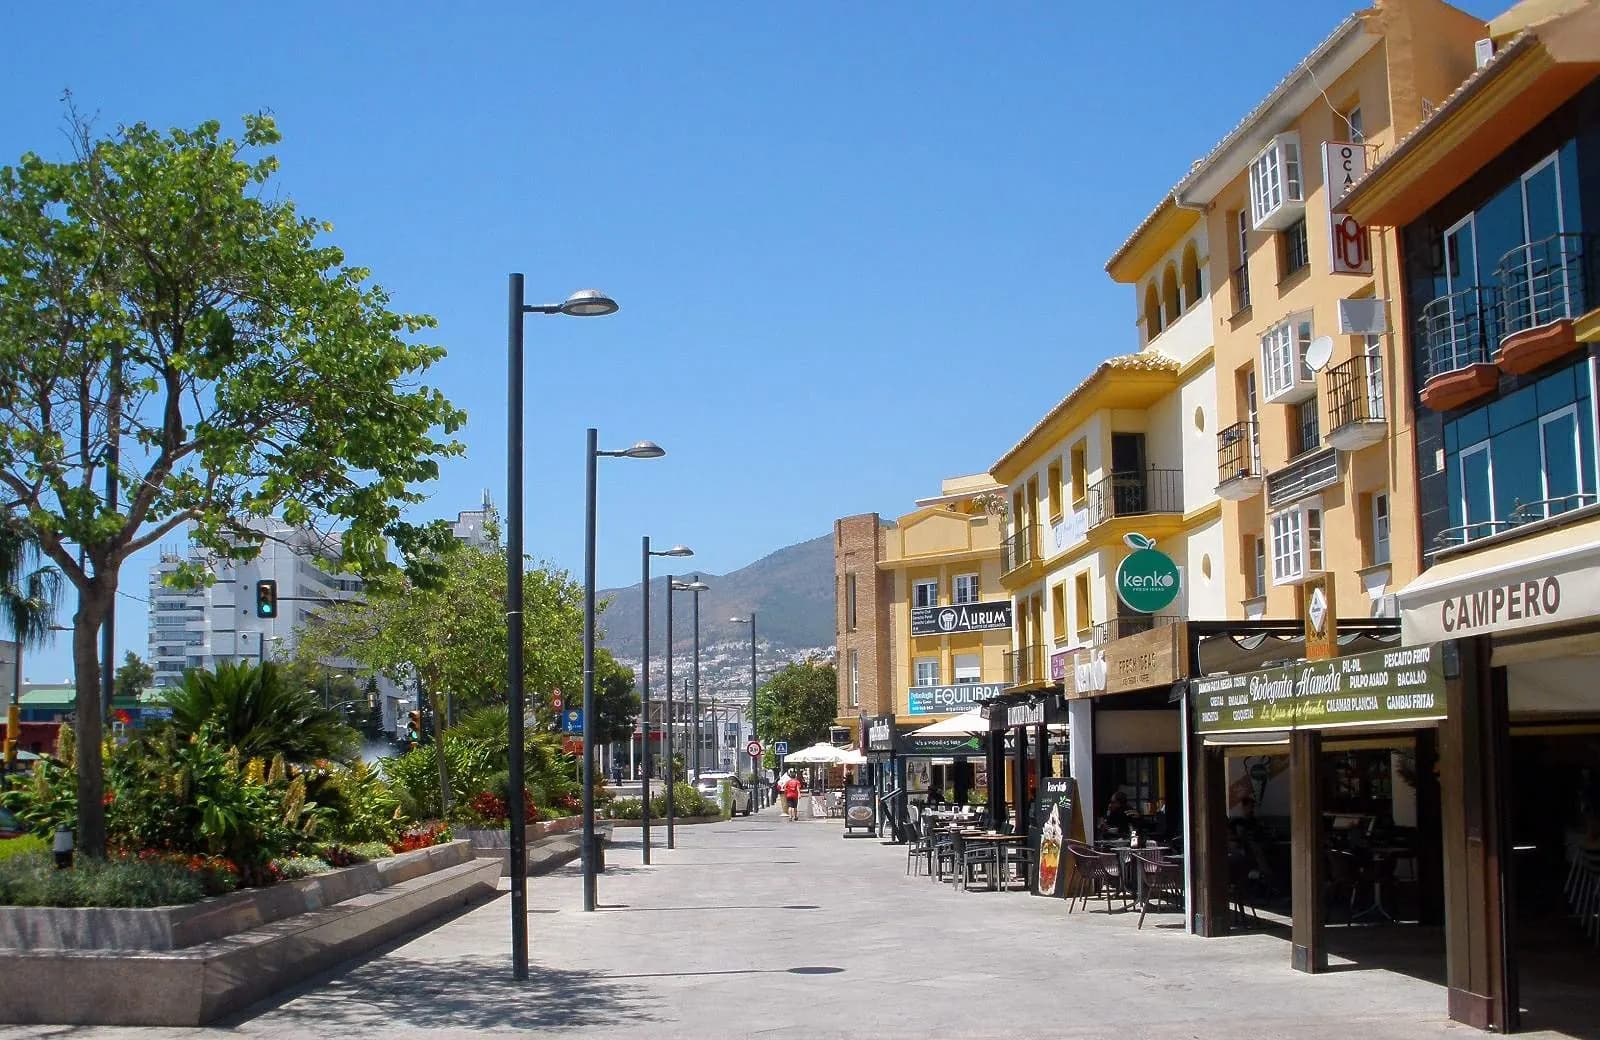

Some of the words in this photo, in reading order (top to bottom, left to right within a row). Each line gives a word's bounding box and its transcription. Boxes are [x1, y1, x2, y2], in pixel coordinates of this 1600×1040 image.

[1441, 575, 1561, 633] CAMPERO
[1119, 657, 1137, 674] FRESH
[1140, 652, 1157, 671] IDEAS
[1342, 658, 1361, 673] PIL-PIL
[1384, 650, 1412, 668] PESCAITO
[1412, 647, 1430, 664] FRITO
[1249, 673, 1293, 704] Bodeguita
[1294, 663, 1341, 697] Alameda
[1349, 674, 1368, 688] PULPO
[1369, 671, 1389, 686] ASADO
[1397, 669, 1427, 686] BACALAO
[934, 686, 1000, 706] EQUILIBRA
[1326, 698, 1352, 713] CALAMAR
[1352, 695, 1378, 711] PLANCHA
[1386, 695, 1413, 710] GAMBAS
[1413, 693, 1434, 709] FRITAS
